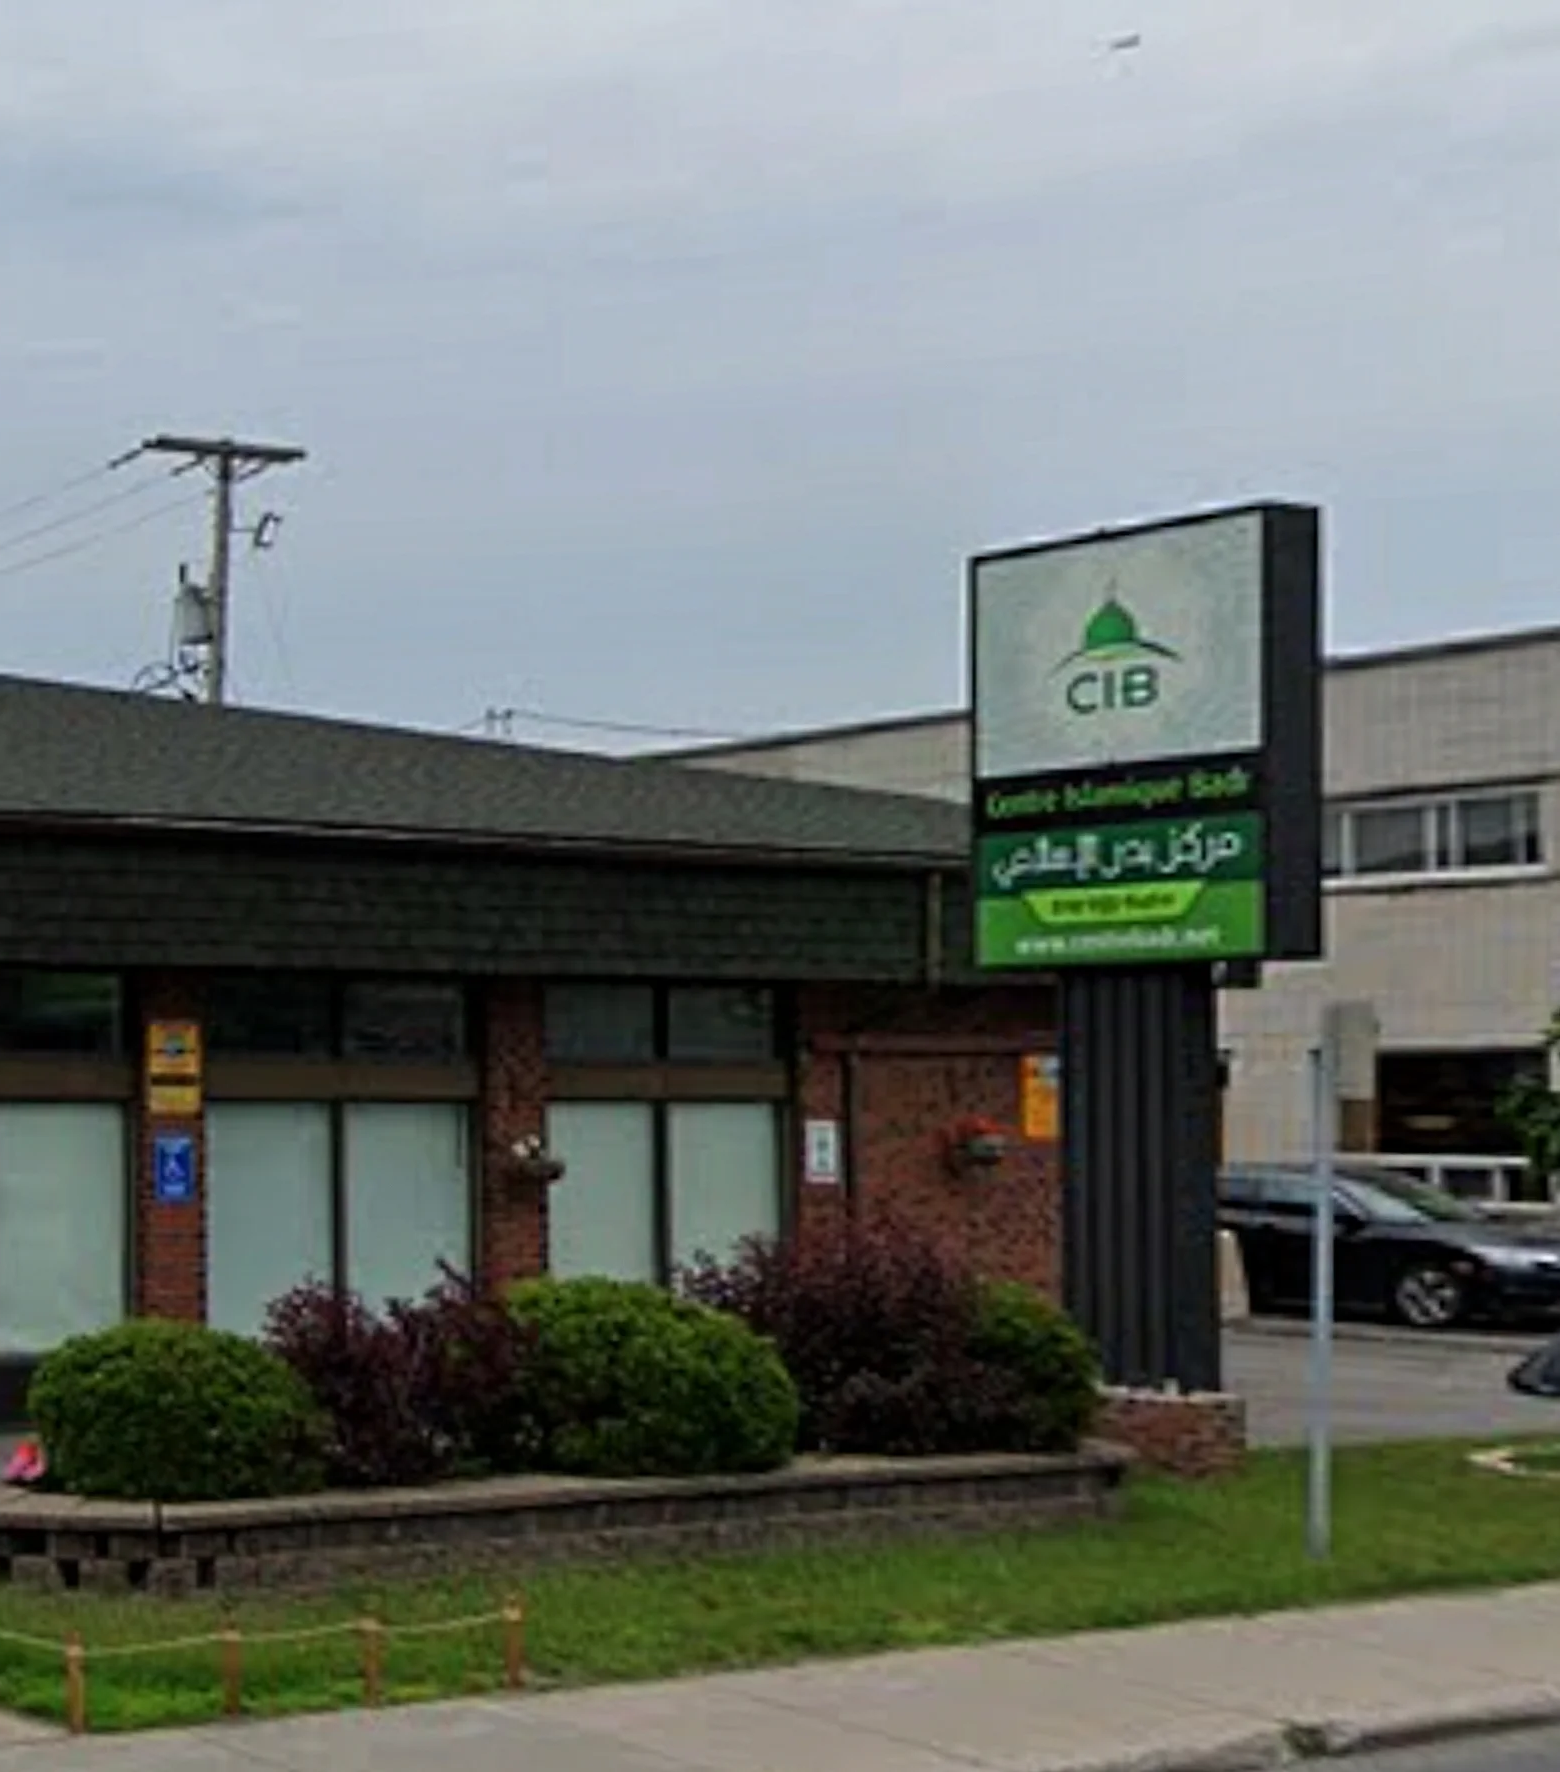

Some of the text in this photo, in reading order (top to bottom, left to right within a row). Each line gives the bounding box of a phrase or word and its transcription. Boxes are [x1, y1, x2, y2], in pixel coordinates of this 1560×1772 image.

[1066, 664, 1161, 715] CIB
[985, 765, 1251, 819] Centre Islamique Badr
[1161, 821, 1243, 874] مركز
